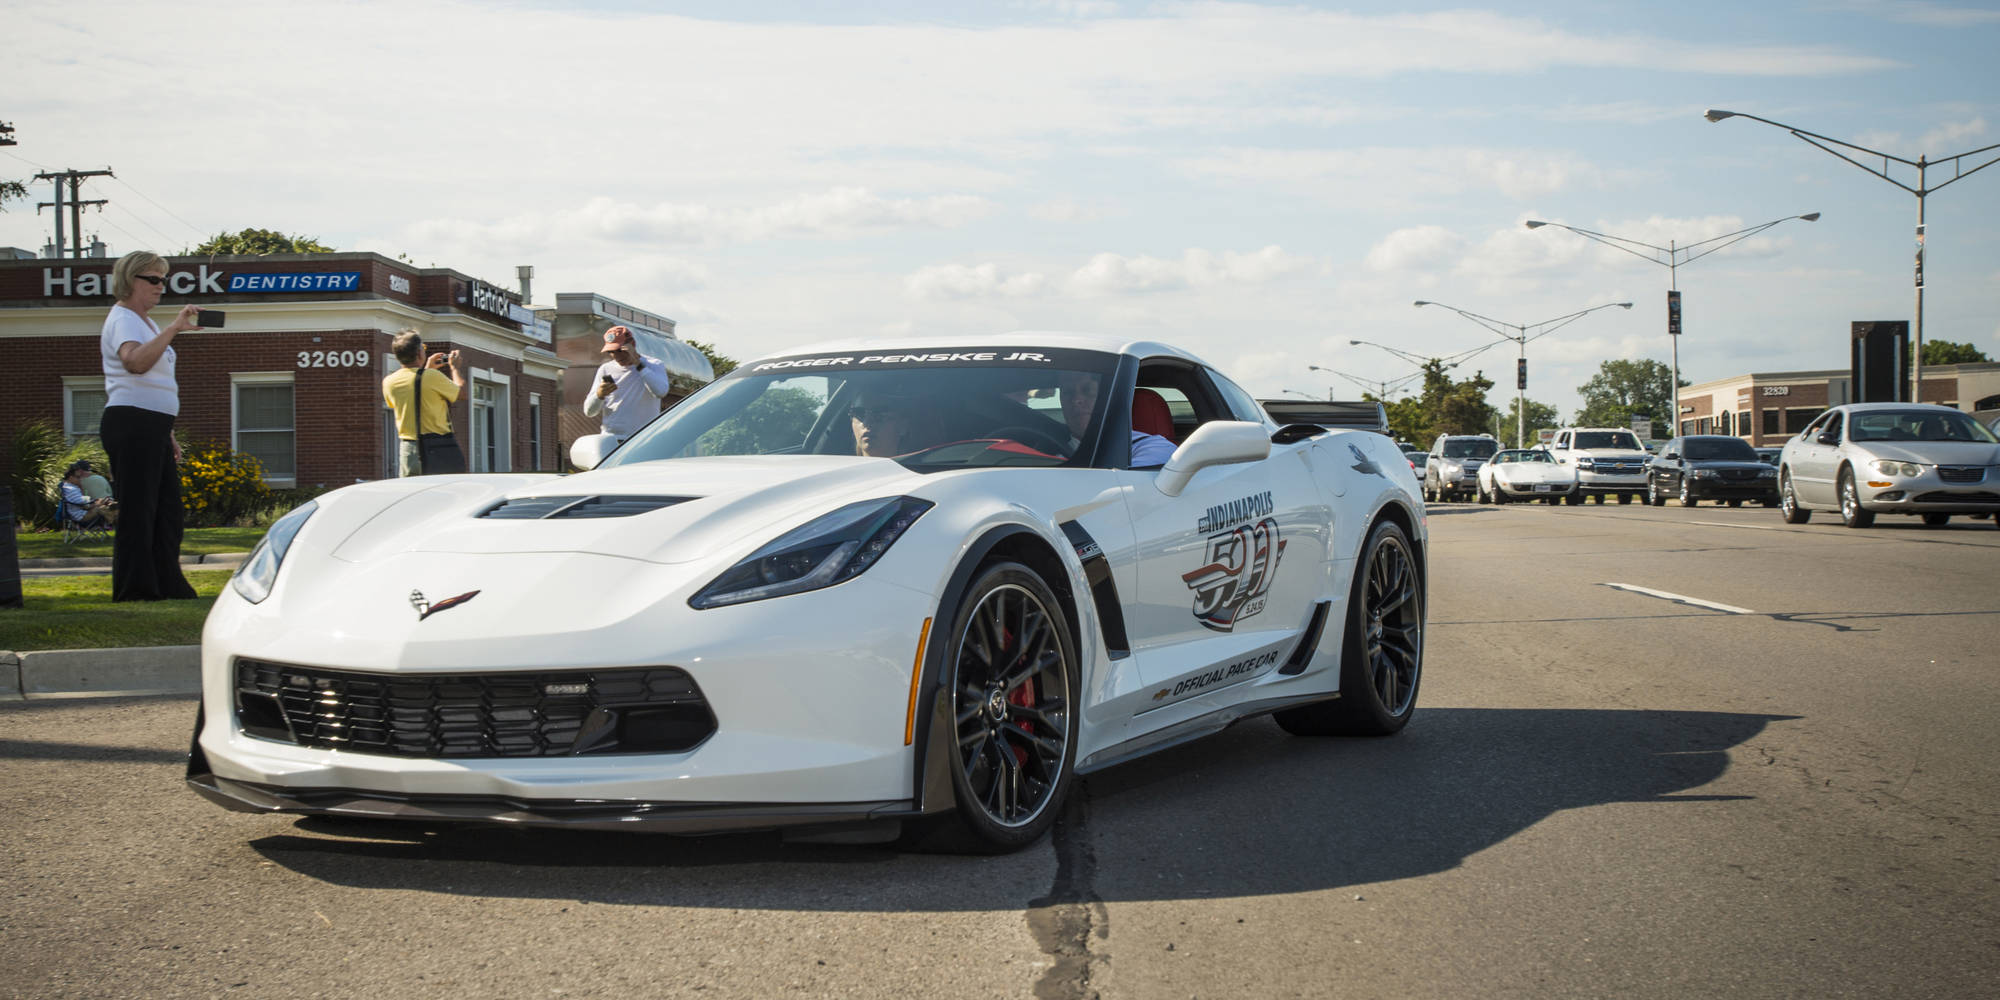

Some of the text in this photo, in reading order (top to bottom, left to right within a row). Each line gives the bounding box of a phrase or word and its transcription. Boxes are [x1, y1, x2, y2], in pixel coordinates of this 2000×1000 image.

[43, 265, 357, 296] Hack DENTISTRY
[297, 350, 370, 368] 32609
[752, 352, 1052, 373] ROGER PENSKE JR.
[1206, 490, 1273, 533] INDIANAPOLIS
[1173, 650, 1279, 697] OFFICIAL PACE CAR
